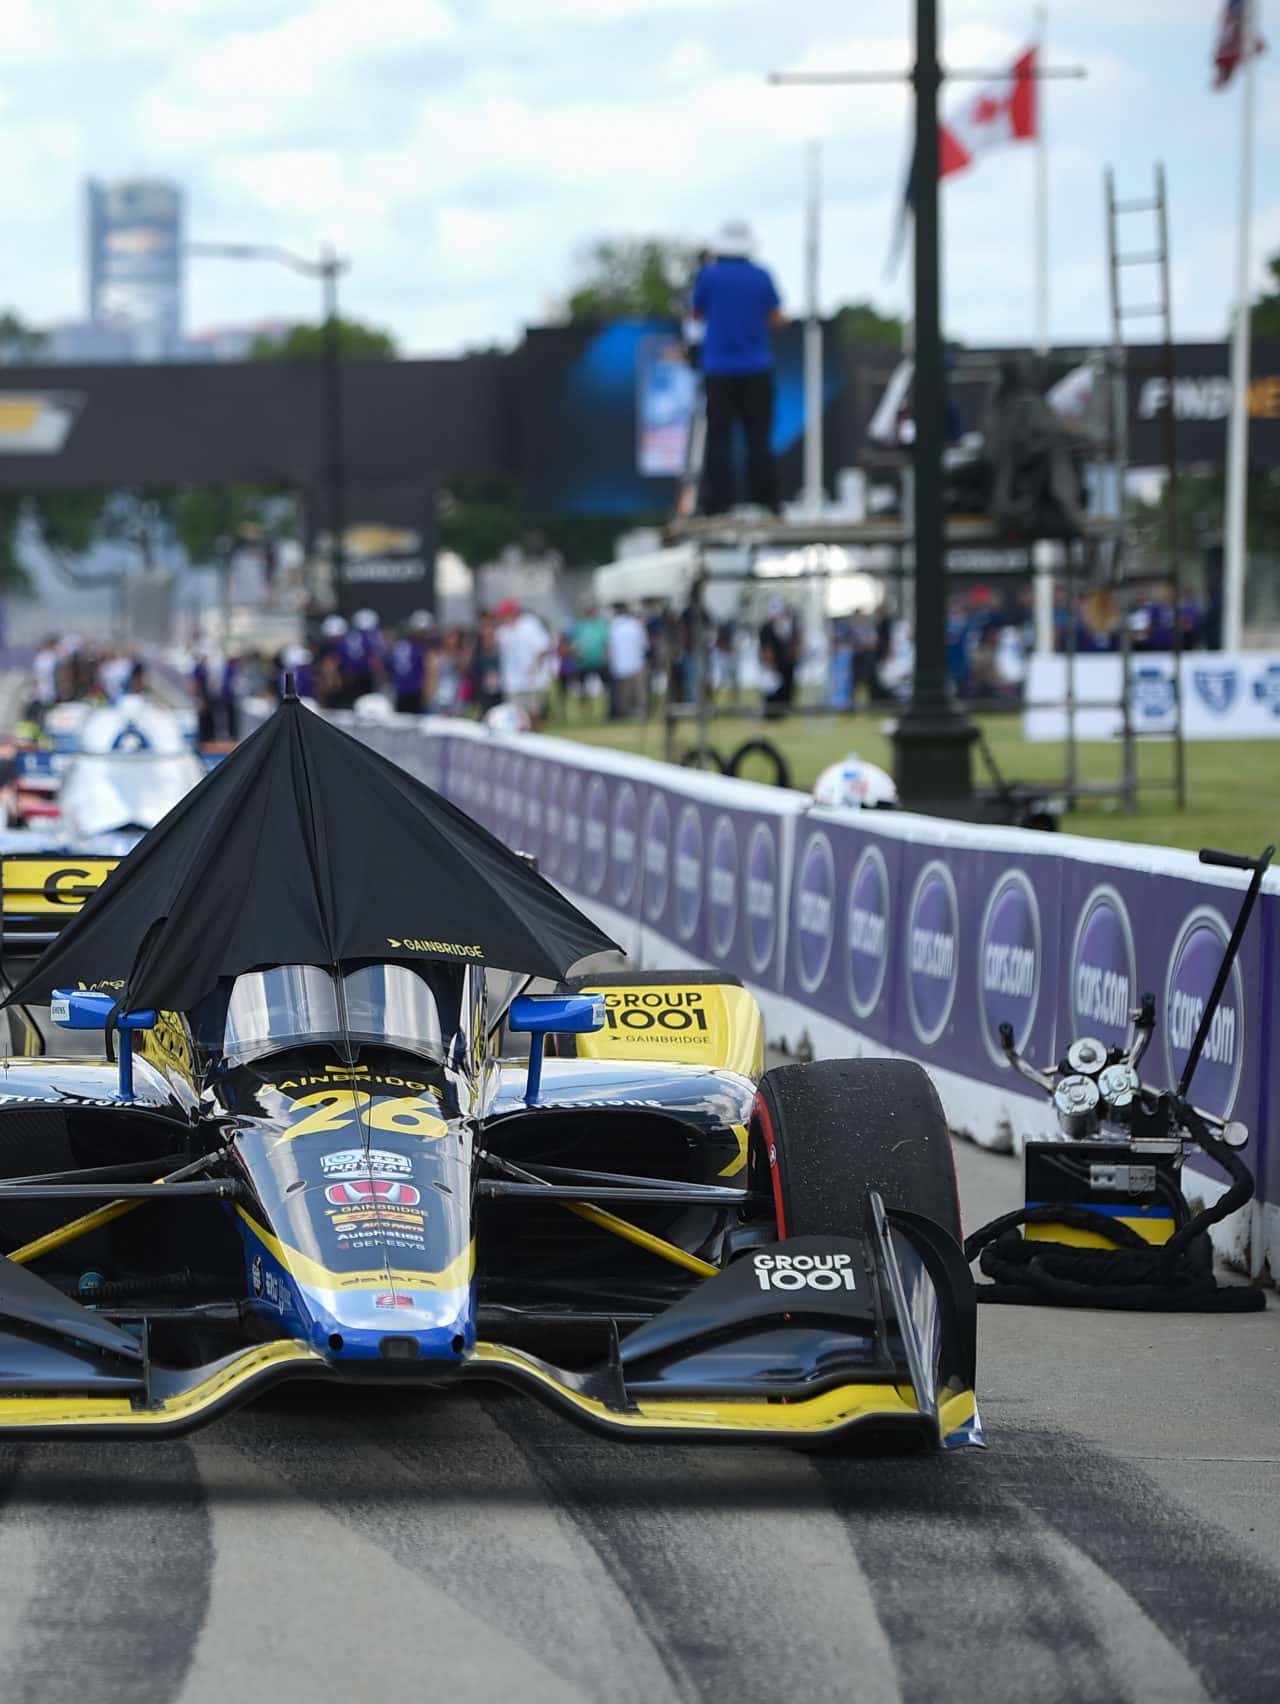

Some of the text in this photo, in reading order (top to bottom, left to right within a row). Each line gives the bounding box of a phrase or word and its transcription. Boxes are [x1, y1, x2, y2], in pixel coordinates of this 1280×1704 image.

[403, 939, 485, 958] GAINBRIDGE
[911, 928, 954, 977] cars.com
[984, 944, 1035, 998] cars.com
[604, 992, 703, 1008] GROUP
[1077, 964, 1130, 1028] cars.com
[606, 1009, 708, 1030] 1001
[625, 1034, 711, 1044] GAINBRIDGE
[272, 1089, 449, 1148] 26
[753, 1254, 852, 1270] GROUP
[754, 1269, 857, 1290] 1001
